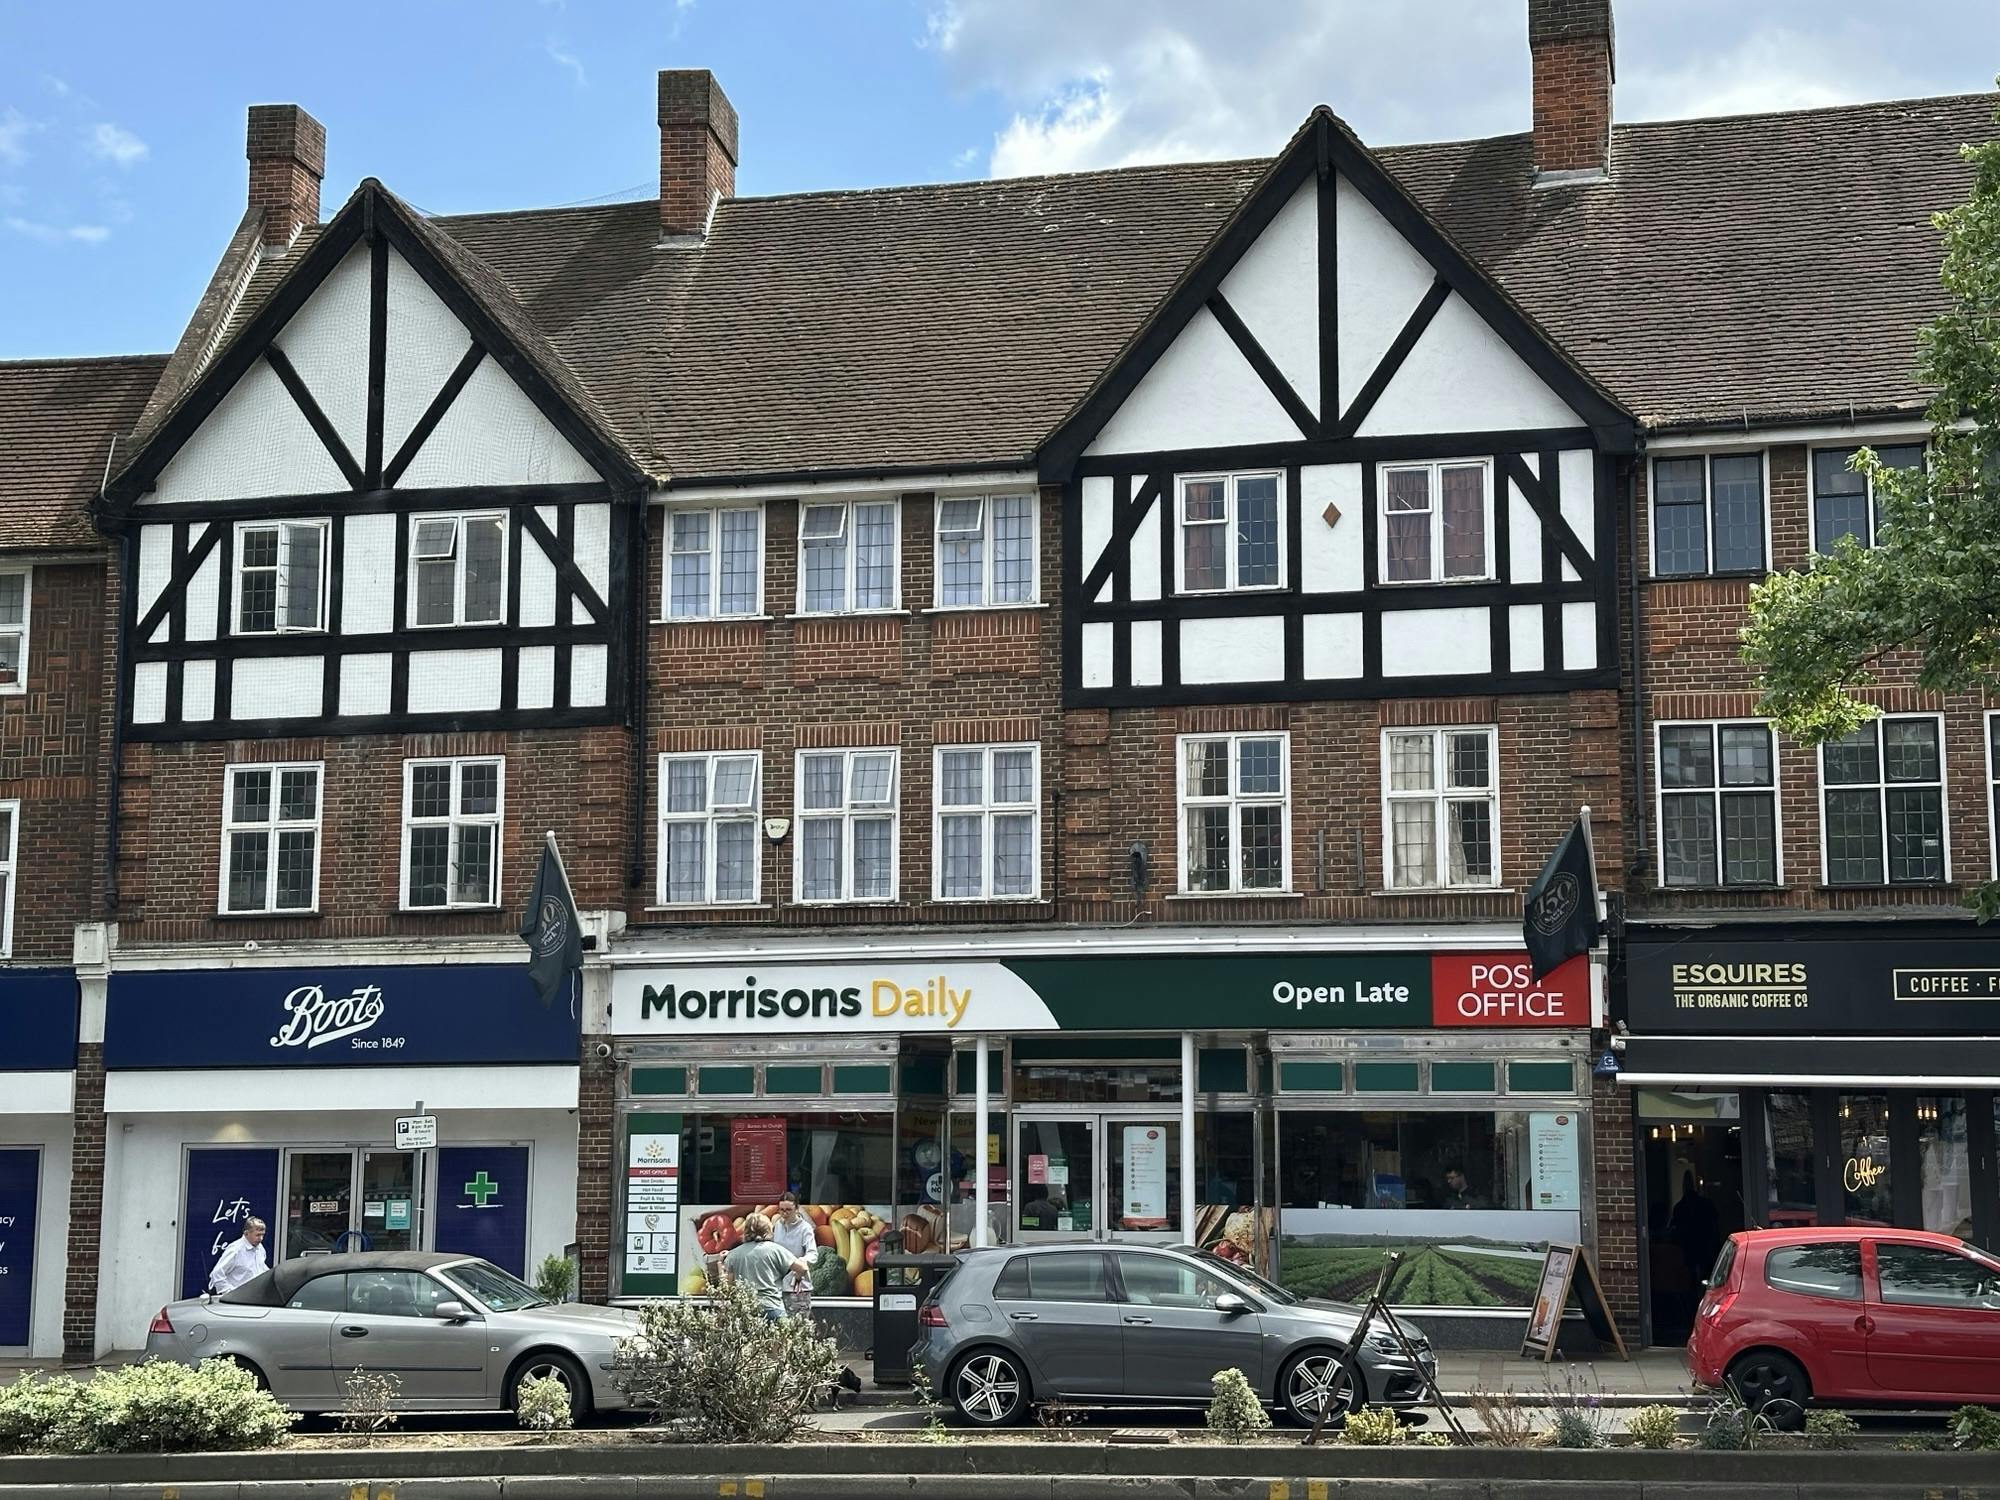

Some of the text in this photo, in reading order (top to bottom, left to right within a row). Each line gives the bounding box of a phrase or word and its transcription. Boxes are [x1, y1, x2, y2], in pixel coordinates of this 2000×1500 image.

[1672, 963, 1807, 985] ESQUIRES
[1910, 976, 1969, 993] COFFEE
[641, 975, 972, 1028] Morrisons Daily
[1272, 981, 1409, 1010] Open Late
[1457, 992, 1565, 1017] OFFICE
[1674, 993, 1695, 1008] THE
[1698, 993, 1749, 1008] ORGANIC
[1752, 993, 1791, 1008] COFFEE
[270, 984, 385, 1049] Boots
[351, 1037, 405, 1049] Since 1849
[1843, 1156, 1885, 1193] Coffee
[212, 1196, 251, 1224] Let's
